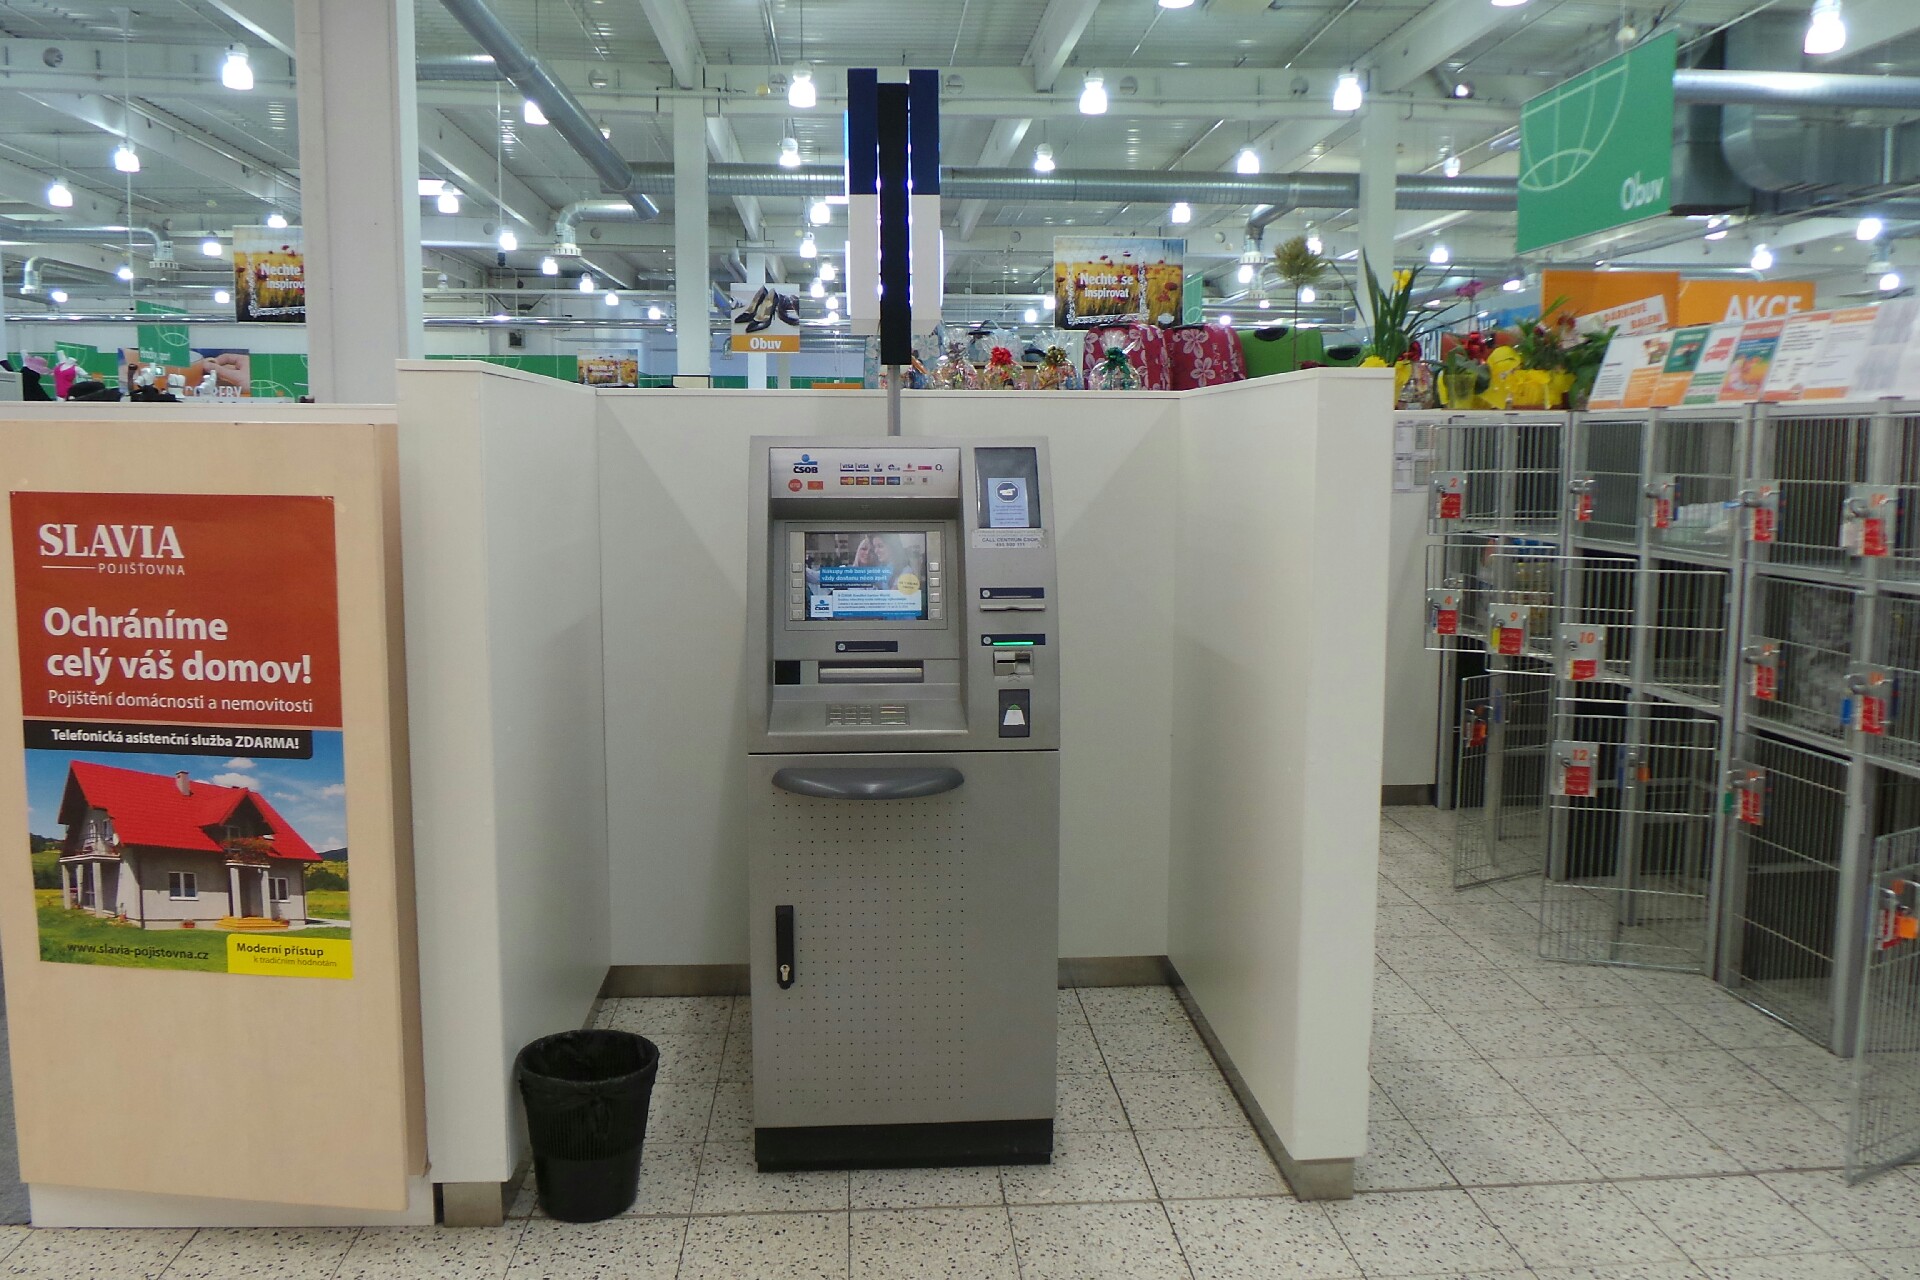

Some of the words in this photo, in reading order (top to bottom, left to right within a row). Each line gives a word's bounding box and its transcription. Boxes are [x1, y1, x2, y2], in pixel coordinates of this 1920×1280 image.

[1620, 171, 1665, 211] Obuv
[260, 262, 300, 276] Nechte
[266, 278, 305, 290] inspirov
[1080, 273, 1118, 285] Nechte
[1120, 276, 1134, 285] se
[1084, 287, 1130, 299] inspirovat
[1725, 294, 1804, 323] AKCE
[750, 338, 781, 349] Obuv
[793, 465, 818, 474] ČSOB
[1450, 477, 1459, 488] 2
[39, 522, 186, 560] SLAVIA
[98, 561, 186, 576] POJIŠŤOVNA
[1445, 596, 1453, 605] 4
[1510, 611, 1519, 622] 9
[44, 606, 228, 641] Ochráníme
[1580, 632, 1595, 643] 10
[46, 646, 113, 686] celý
[119, 649, 175, 681] váš
[181, 649, 313, 685] domov!
[48, 689, 113, 712] Pojištění
[115, 692, 205, 711] domácnosti
[207, 698, 218, 711] a
[221, 697, 313, 713] nemovitosti
[51, 728, 124, 745] Telefonická
[125, 730, 189, 747] asistenční
[190, 732, 234, 748] služba
[234, 734, 300, 750] ZDARMA!
[1573, 749, 1588, 760] 12
[67, 942, 210, 961] www.slavia-pojistovna.cz
[236, 943, 282, 954] Moderní
[284, 944, 324, 958] přístup
[253, 956, 258, 964] k
[258, 956, 296, 966] tradičním
[296, 958, 338, 968] hodnotám
